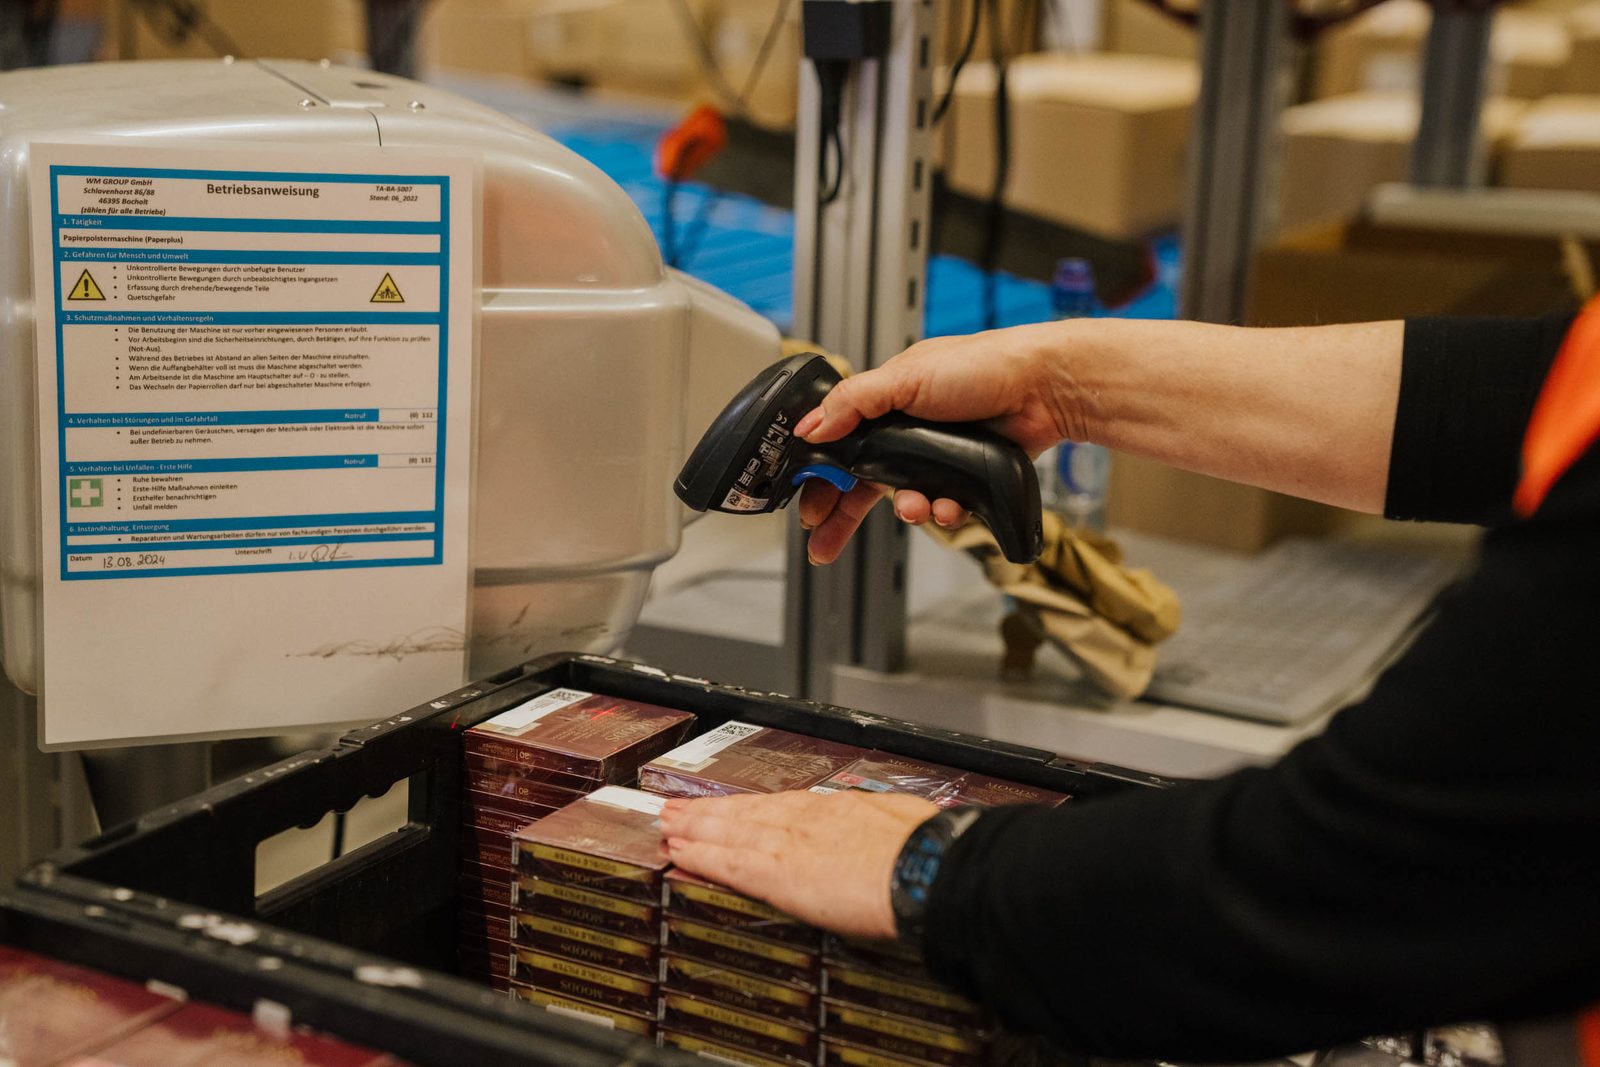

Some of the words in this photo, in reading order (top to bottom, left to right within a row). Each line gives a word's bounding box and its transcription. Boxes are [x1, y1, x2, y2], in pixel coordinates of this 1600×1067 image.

[86, 177, 101, 185] WM
[134, 188, 155, 196] 86/88
[207, 184, 319, 198] Betriebsanweisung
[369, 194, 390, 202] Stand:
[80, 206, 106, 214] (zählen
[107, 207, 118, 215] für
[135, 208, 166, 216] Betriebe)
[71, 218, 102, 227] Tätigkeit
[63, 234, 143, 242] Papierpolstermaschine
[145, 236, 183, 244] (Paperplus)
[179, 275, 221, 283] Bewegungen
[127, 284, 160, 292] Erfassung
[180, 285, 253, 293] drehende/bewegende
[127, 294, 176, 302] Quetschgefahr
[74, 314, 141, 322] Schutzmaßnahmen
[157, 315, 214, 323] Verhaltensregeln
[141, 327, 175, 335] Benutzung
[267, 327, 314, 335] eingewiesenen
[215, 336, 296, 344] Sicherheitseinrichtungen,
[315, 336, 347, 344] Betätigen,
[162, 364, 214, 372] Auffangbehälter
[248, 373, 292, 381] Hauptschalter
[188, 383, 227, 391] Papierrollen
[267, 382, 313, 390] abgeschalteter
[344, 381, 371, 389] erfolgen.
[77, 416, 111, 424] Verhalten
[112, 416, 124, 424] bei
[184, 415, 218, 423] Gefahrfall
[165, 493, 217, 501] benachrichtigen
[133, 523, 170, 531] Entsorgung
[131, 534, 172, 543] Reparaturen
[186, 532, 244, 541] Wartungsarbeiten
[291, 528, 332, 536] fachkundigen
[363, 526, 402, 534] durchgeführt
[235, 548, 272, 556] Unterschrift
[102, 554, 166, 569] 13.08.2024
